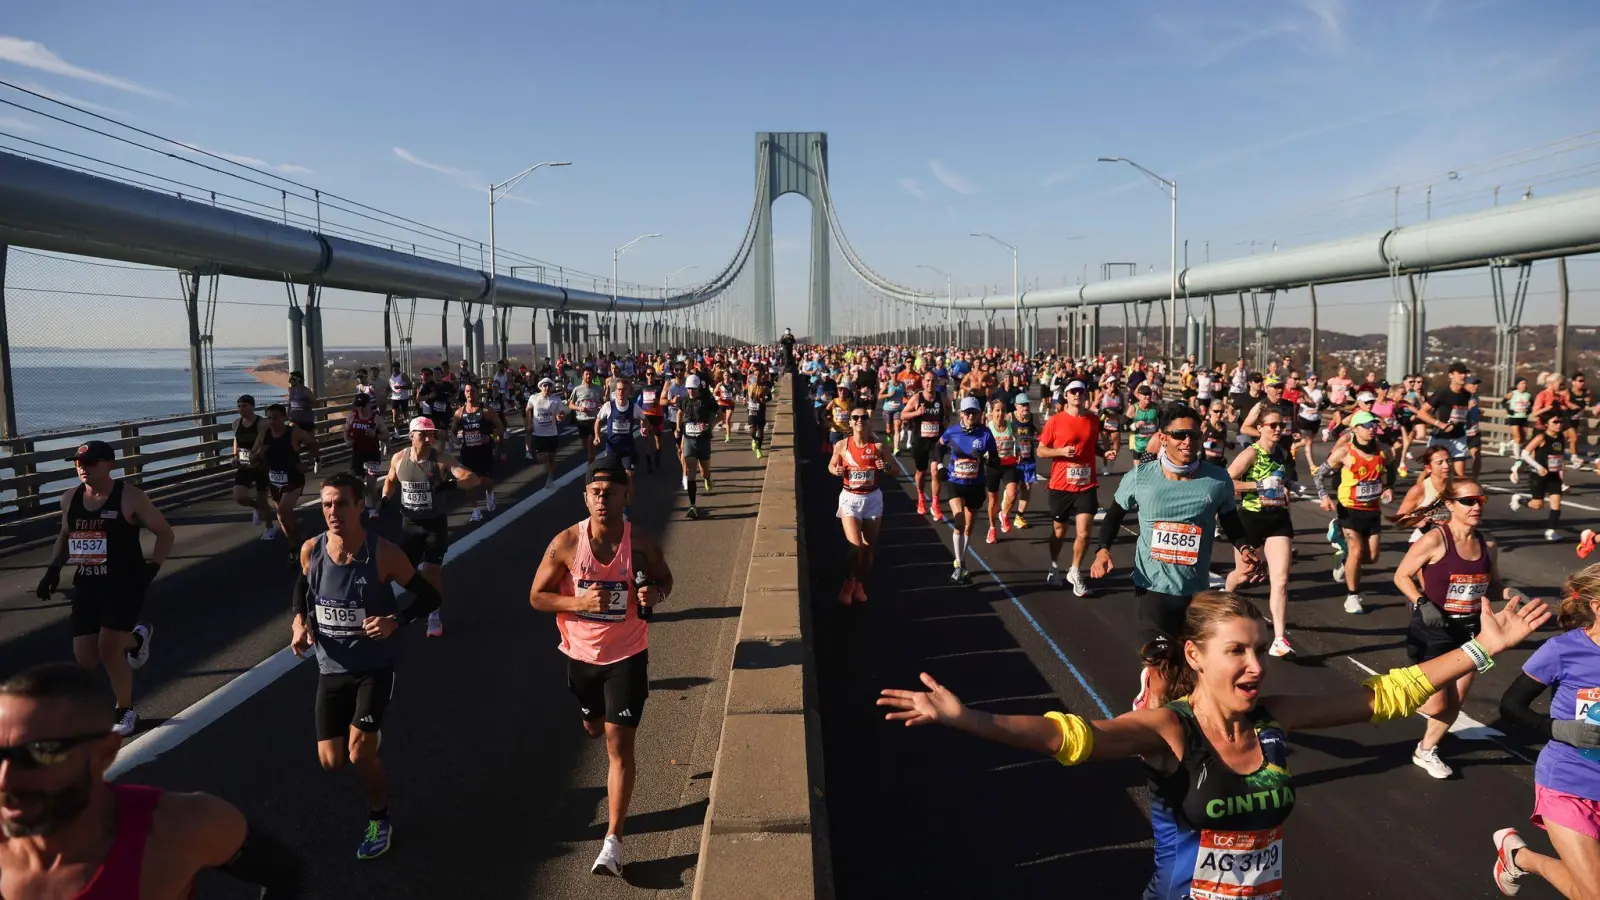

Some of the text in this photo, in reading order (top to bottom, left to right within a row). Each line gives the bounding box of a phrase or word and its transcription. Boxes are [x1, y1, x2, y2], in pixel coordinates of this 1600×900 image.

[407, 493, 428, 502] 4879
[71, 539, 103, 551] 14537
[1156, 531, 1196, 548] 14585
[1450, 585, 1466, 595] AG
[320, 597, 331, 606] tcs
[324, 607, 357, 622] 5195
[1206, 785, 1295, 819] CINTIA
[1213, 832, 1235, 848] tcs
[1200, 844, 1280, 872] AG 3129
